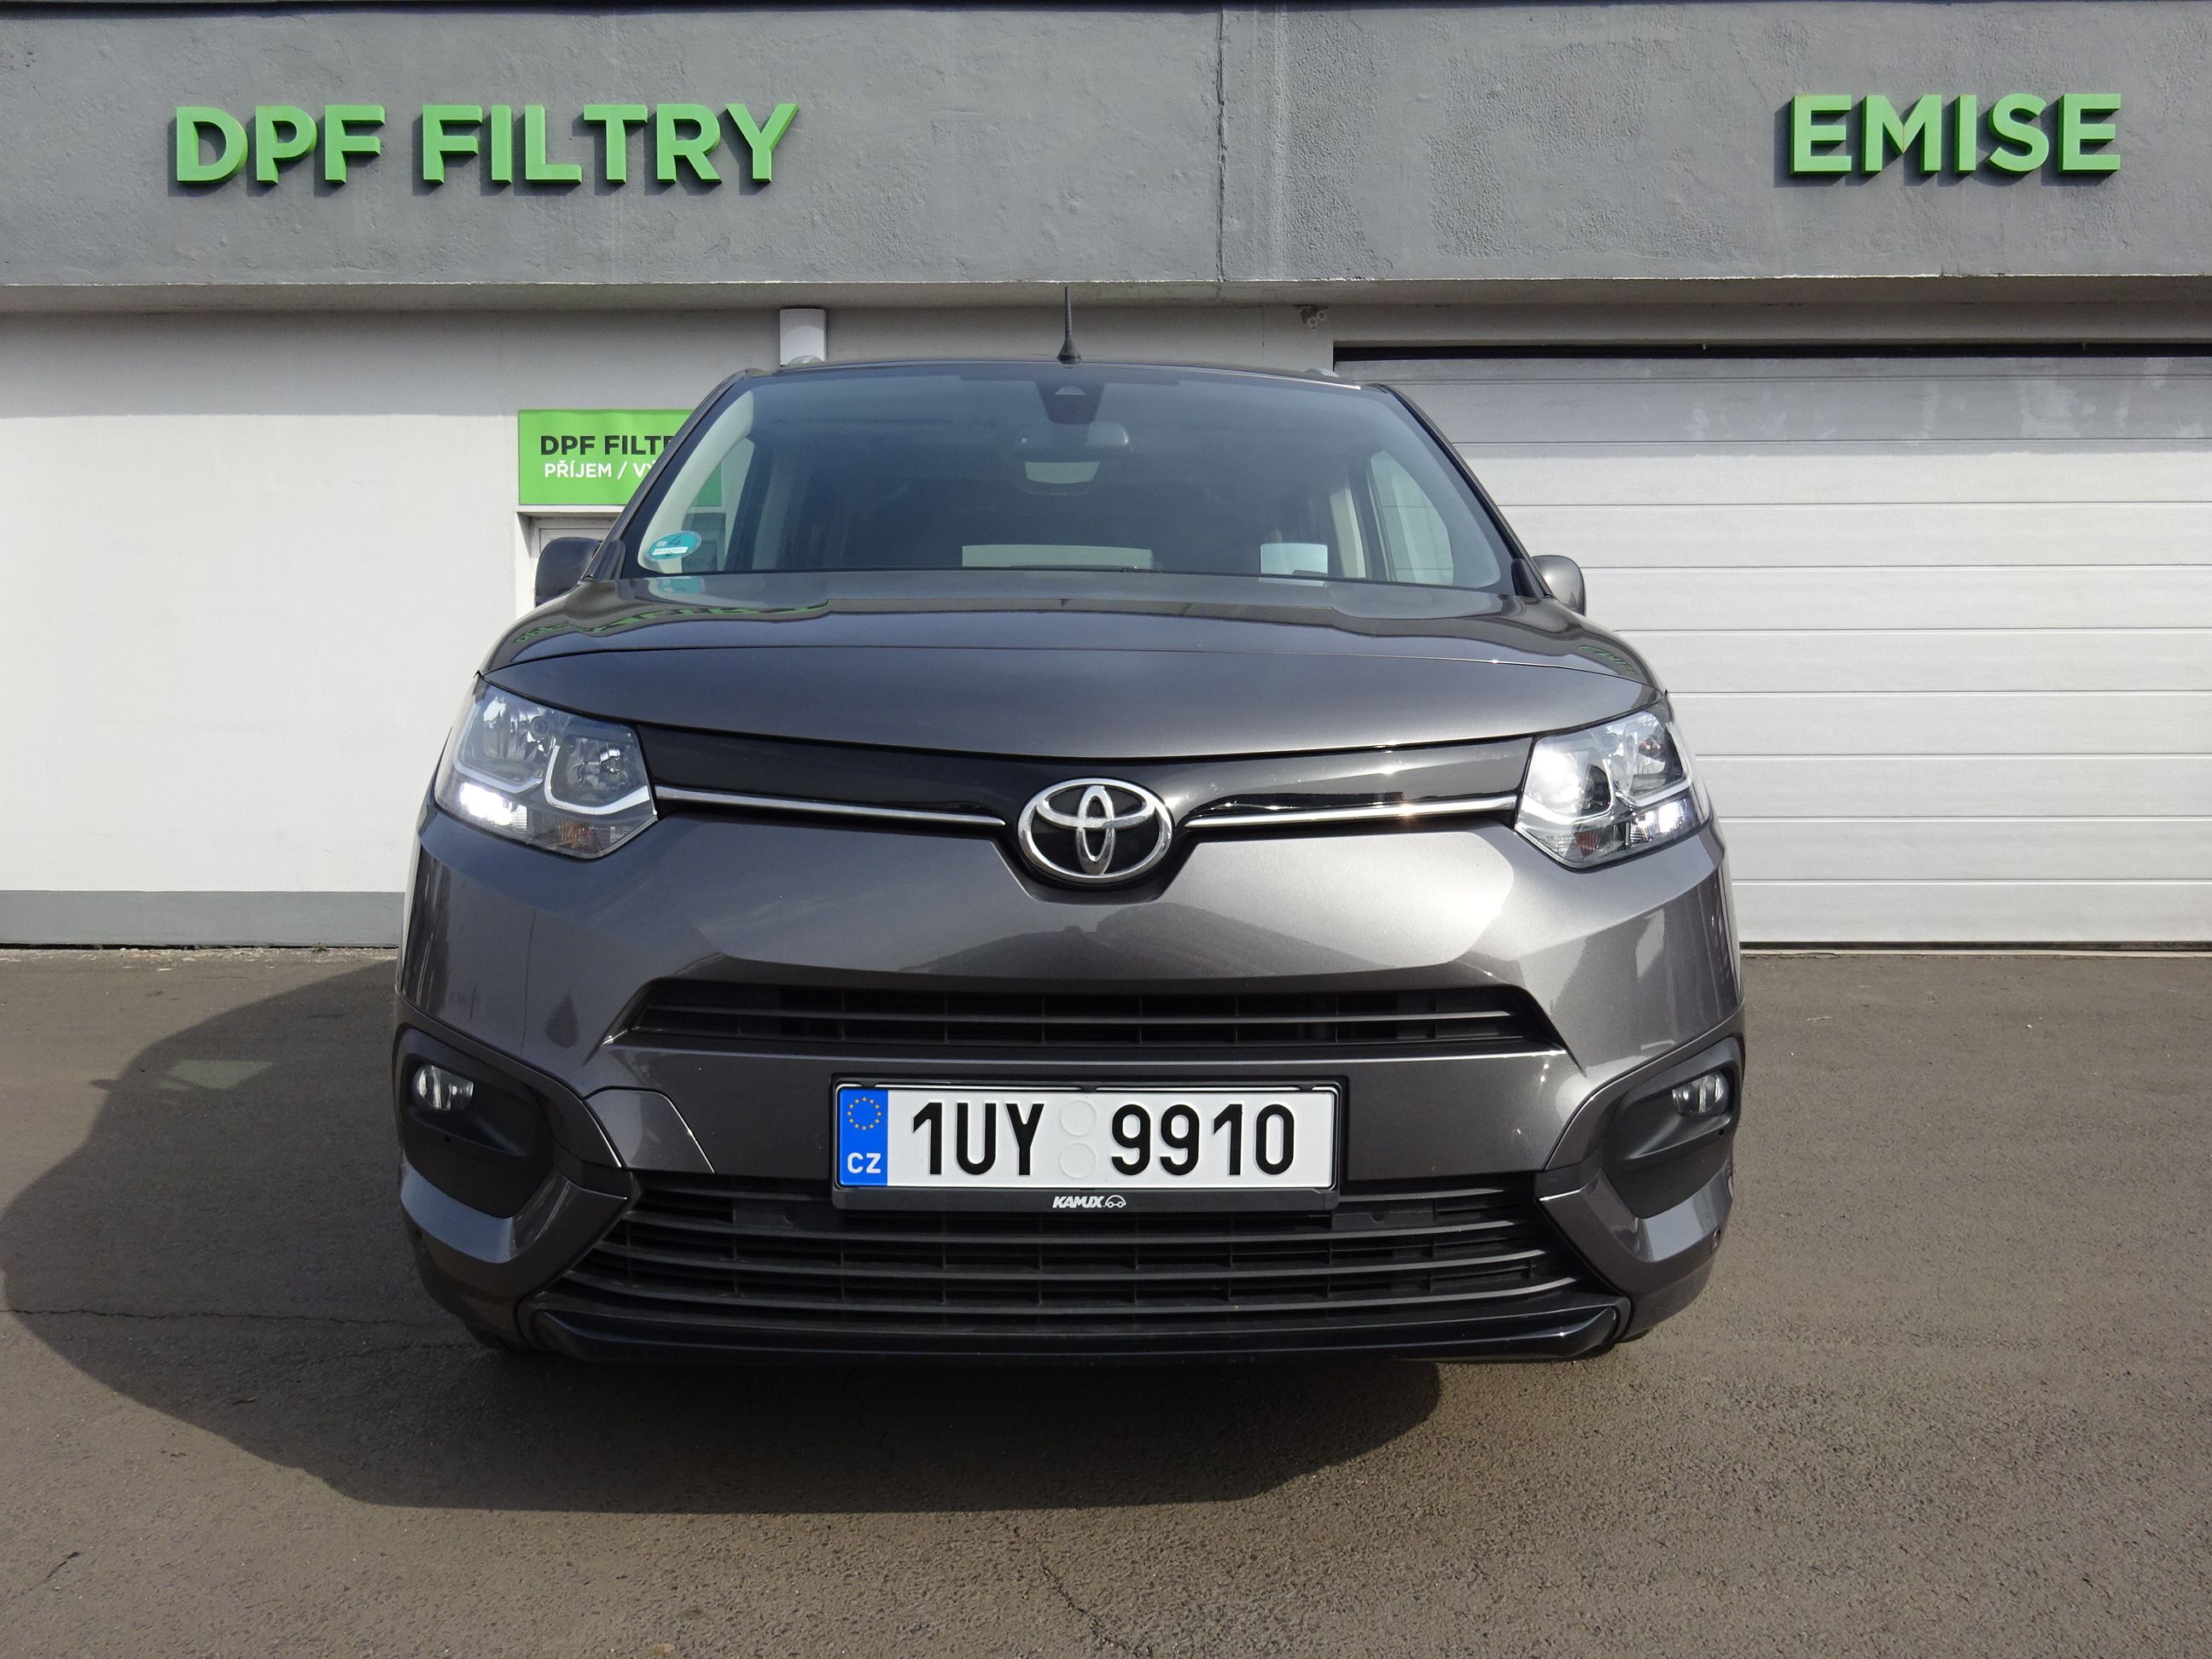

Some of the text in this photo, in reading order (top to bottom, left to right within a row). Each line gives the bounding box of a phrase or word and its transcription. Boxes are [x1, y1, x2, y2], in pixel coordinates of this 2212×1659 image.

[176, 103, 799, 184] DPF FILTRY
[1790, 92, 2122, 174] EMISE
[540, 435, 596, 455] DPF
[544, 459, 612, 478] PŘÍJEM
[912, 1102, 1295, 1176] 1UY 9910
[847, 1152, 882, 1174] CZ
[1052, 1196, 1105, 1208] KAMUX
